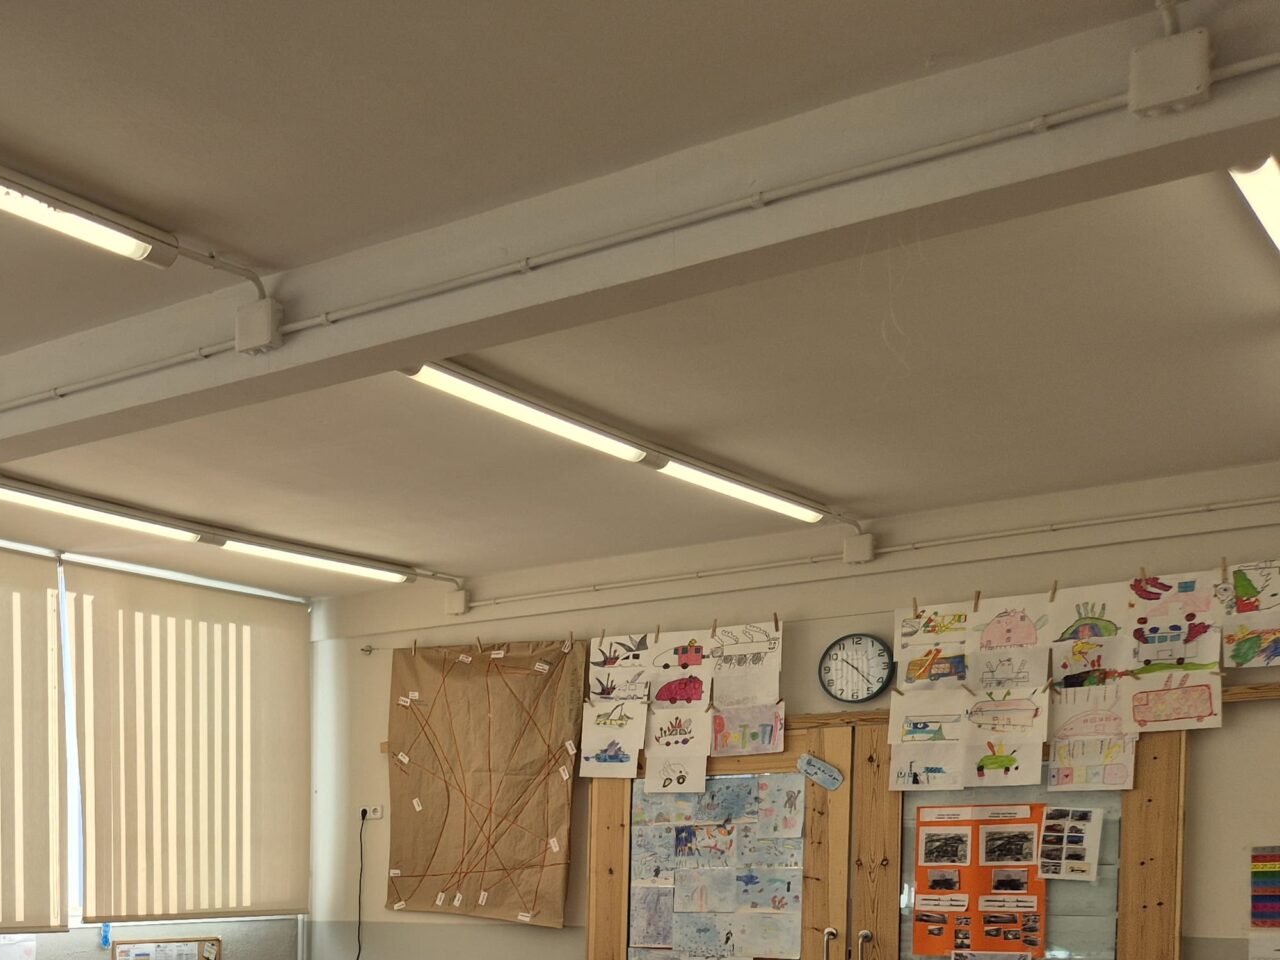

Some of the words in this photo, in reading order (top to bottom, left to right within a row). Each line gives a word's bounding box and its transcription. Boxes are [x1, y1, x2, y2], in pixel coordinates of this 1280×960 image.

[852, 637, 862, 645] 12
[838, 643, 845, 651] 11
[828, 653, 838, 661] 10
[878, 649, 885, 657] 2
[823, 666, 831, 674] 9
[882, 662, 889, 670] 3
[827, 679, 834, 687] 8
[876, 676, 884, 685] 4
[838, 688, 845, 696] 7
[866, 686, 873, 695] 5
[851, 691, 859, 700] 6
